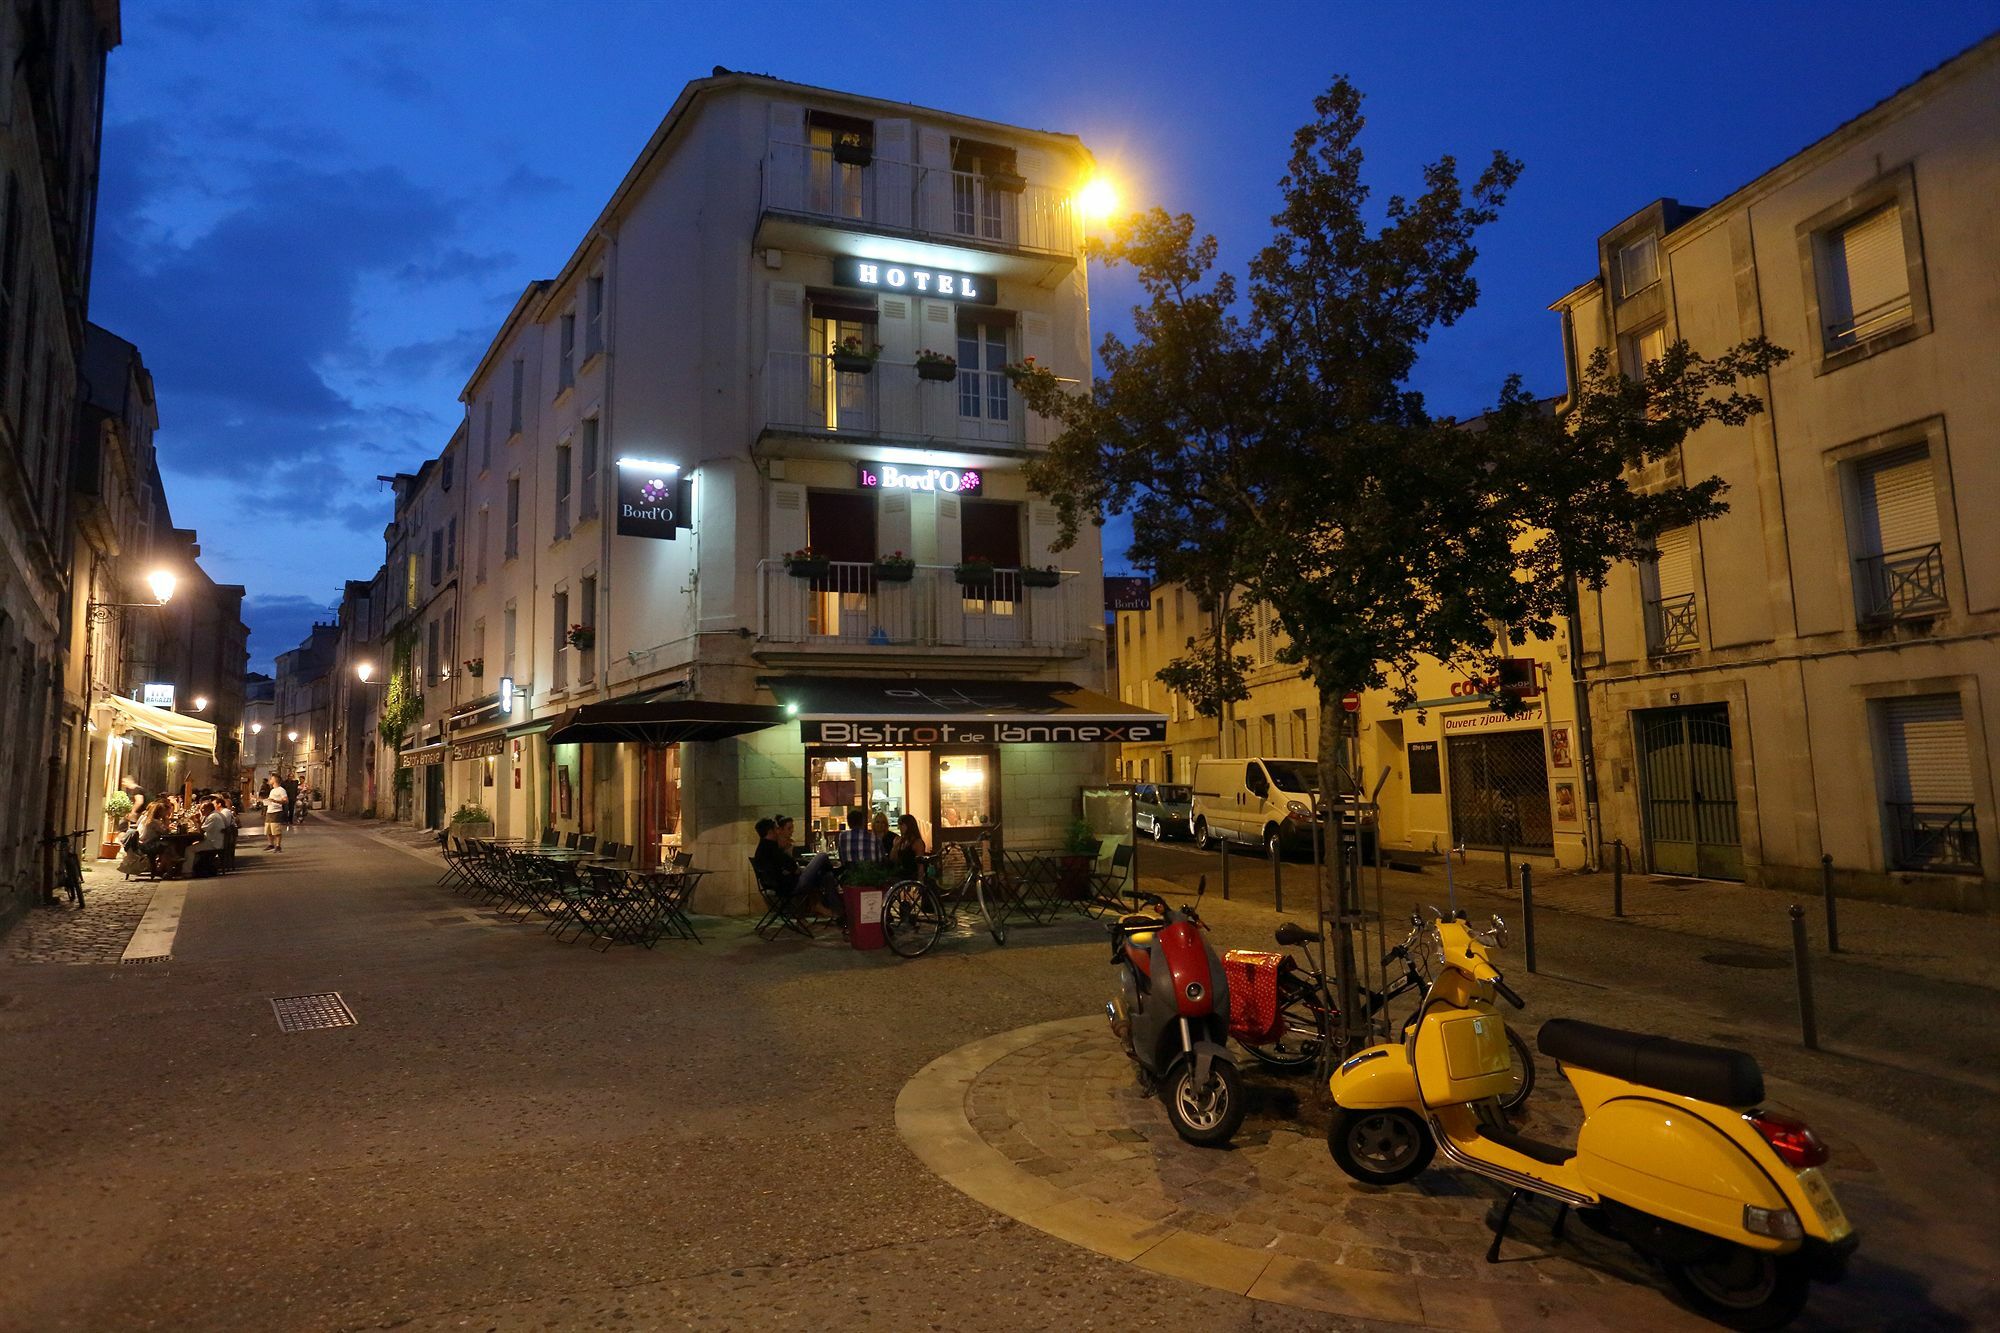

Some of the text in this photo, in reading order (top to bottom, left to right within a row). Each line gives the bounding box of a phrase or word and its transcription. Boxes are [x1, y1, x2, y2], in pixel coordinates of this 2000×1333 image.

[859, 263, 977, 297] HOTEL
[862, 466, 961, 492] le Bord'O
[622, 503, 674, 522] Bord'O
[1445, 718, 1477, 729] Ouvert
[1514, 711, 1534, 722] sur
[1537, 709, 1543, 720] 7
[820, 722, 1151, 743] Bistrot de l'annexe
